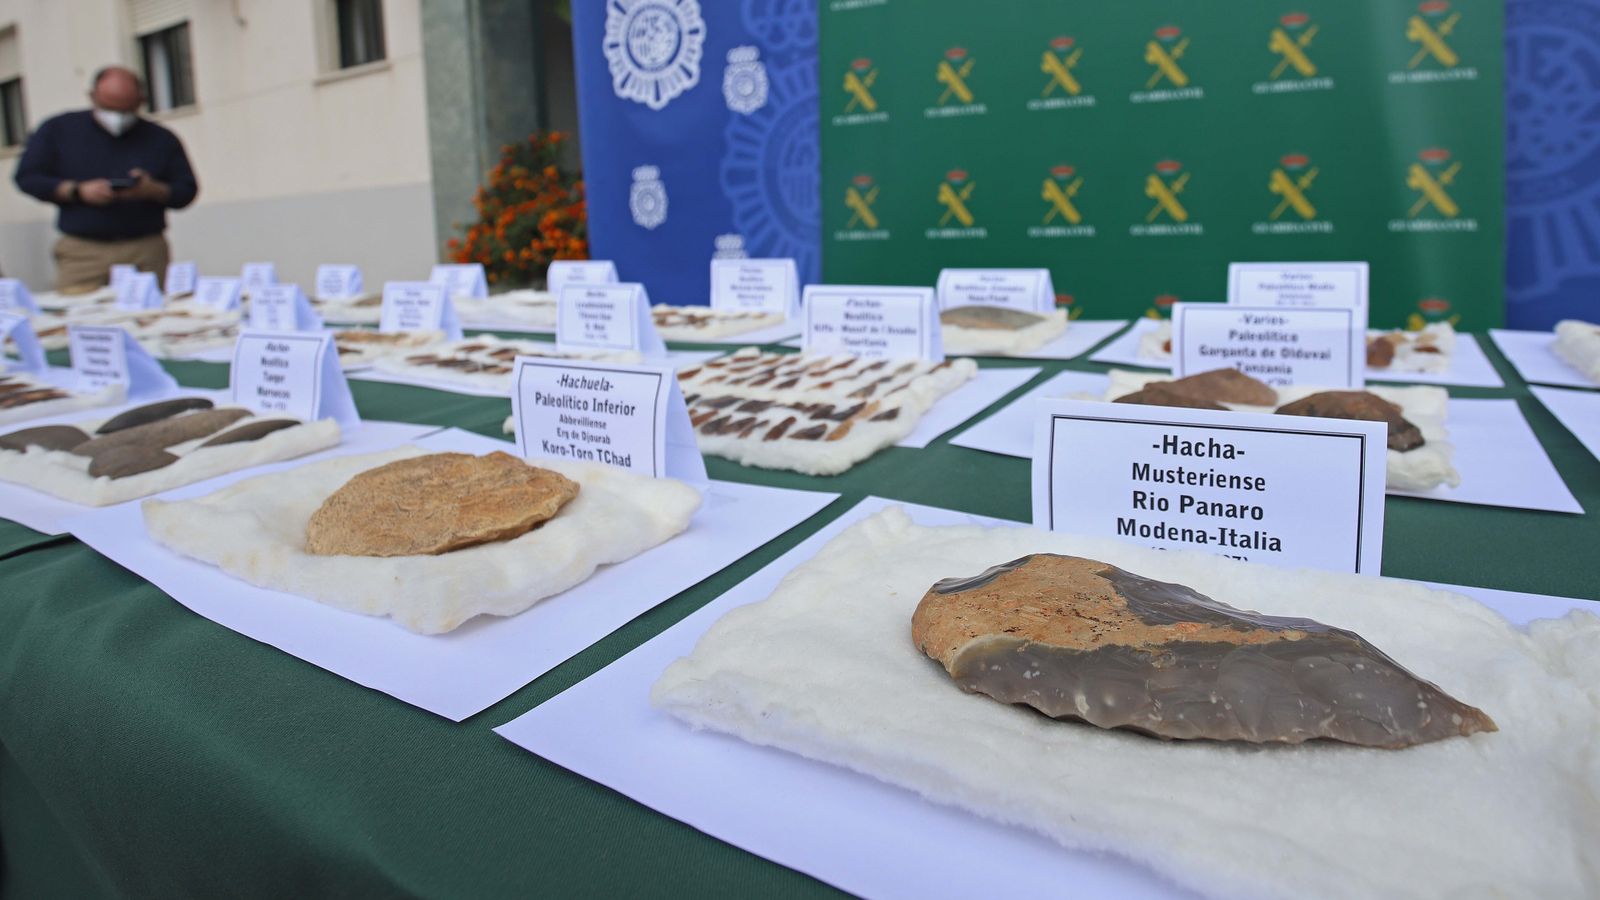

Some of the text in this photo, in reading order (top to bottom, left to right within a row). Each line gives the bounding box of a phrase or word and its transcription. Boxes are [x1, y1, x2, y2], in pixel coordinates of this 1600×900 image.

[556, 373, 614, 392] -Hachuela-
[592, 397, 636, 417] Inferior
[559, 414, 607, 429] Abbevilliense
[571, 430, 580, 440] de
[581, 430, 611, 445] Djourab
[1152, 433, 1246, 460] -Hacha-
[596, 448, 632, 468] TChad
[1131, 462, 1267, 492] Musteriense
[1132, 490, 1265, 522] Rio Panaro
[1116, 517, 1283, 553] Modena-Italia
